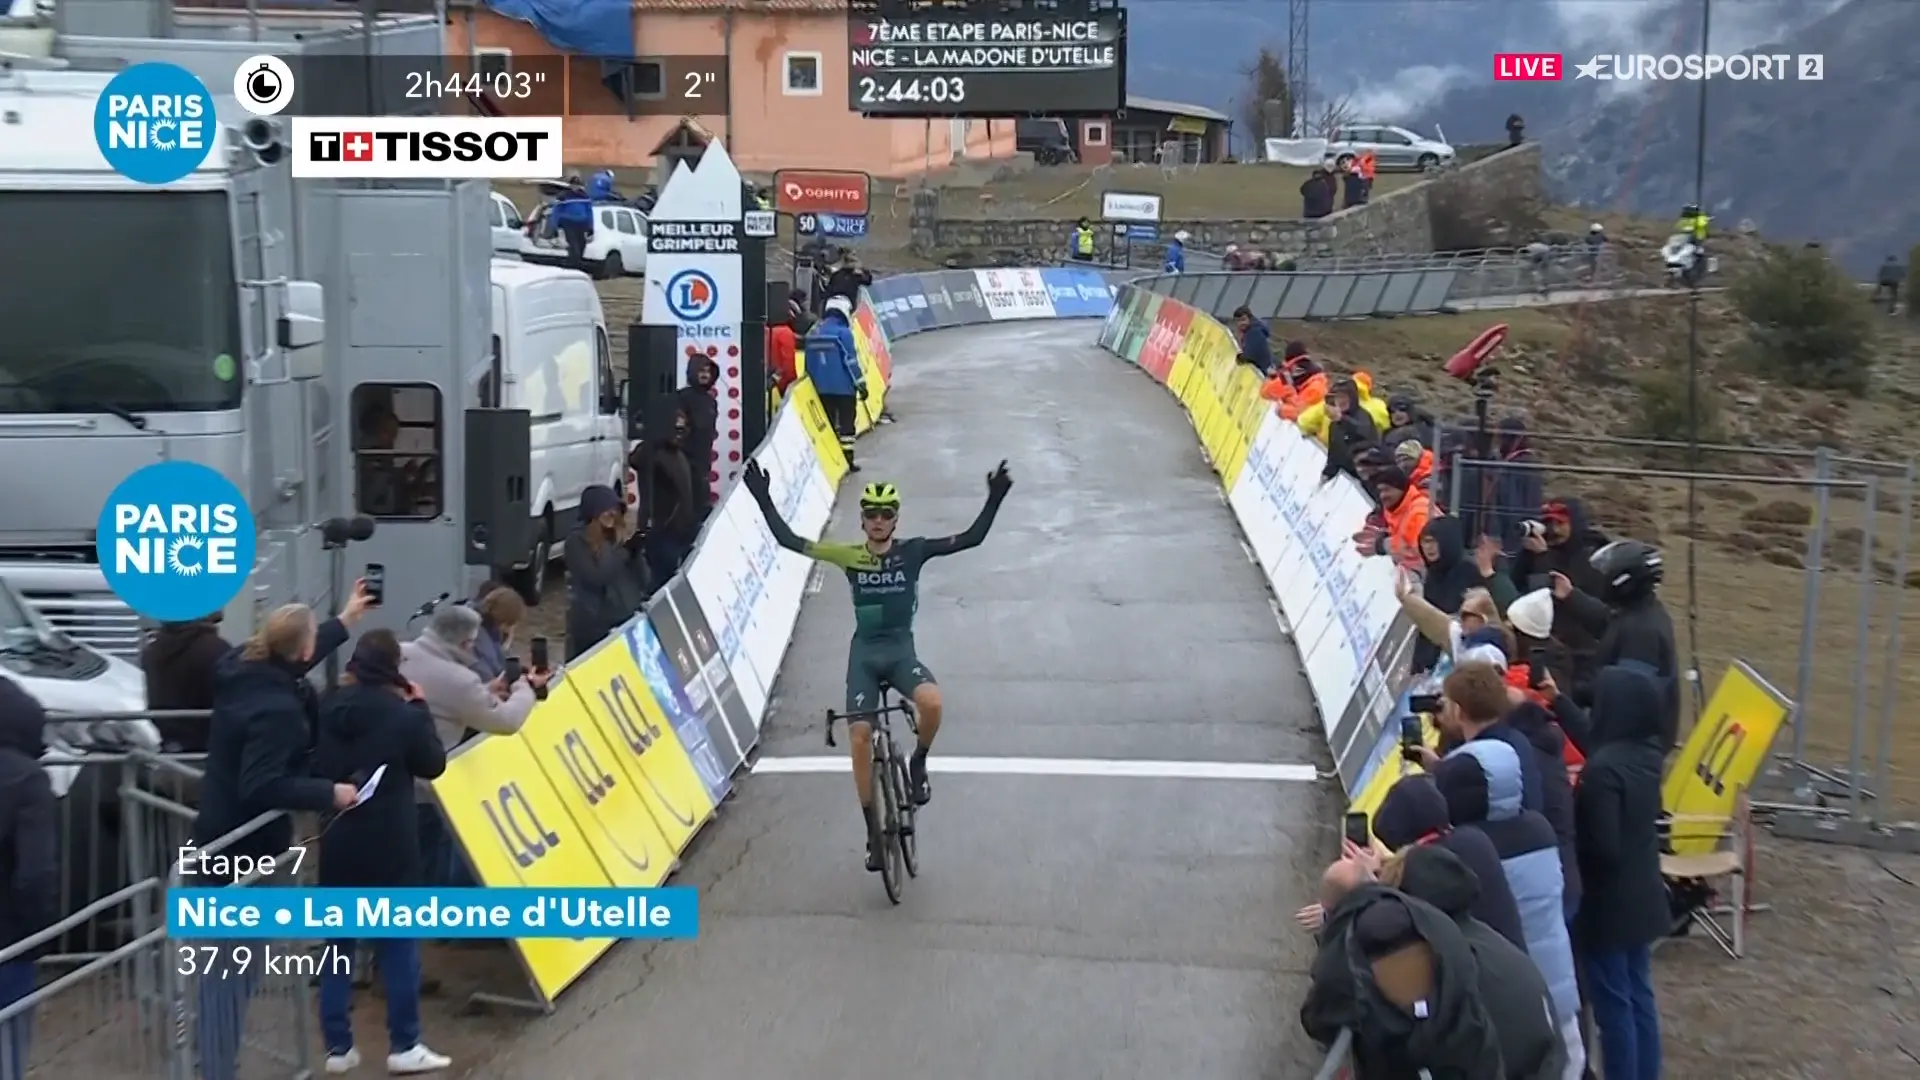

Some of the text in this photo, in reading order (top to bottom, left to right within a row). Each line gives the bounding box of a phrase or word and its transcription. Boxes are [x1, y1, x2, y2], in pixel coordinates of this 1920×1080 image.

[868, 18, 1099, 41] 7ÈME ETAPE PARIS-NICE
[852, 49, 896, 66] NICE
[914, 48, 938, 65] LA
[943, 48, 1026, 65] MADONE
[1032, 47, 1114, 64] D'UTELLE
[859, 76, 965, 102] 2:44:03
[652, 223, 734, 236] MEILLEUR
[799, 215, 816, 231] 50
[652, 238, 738, 251] GRIMPEUR
[677, 323, 731, 337] eclerc
[857, 570, 906, 585] BORA
[597, 673, 661, 756] LCL
[554, 728, 616, 806] LCL
[480, 781, 560, 868] LCL
